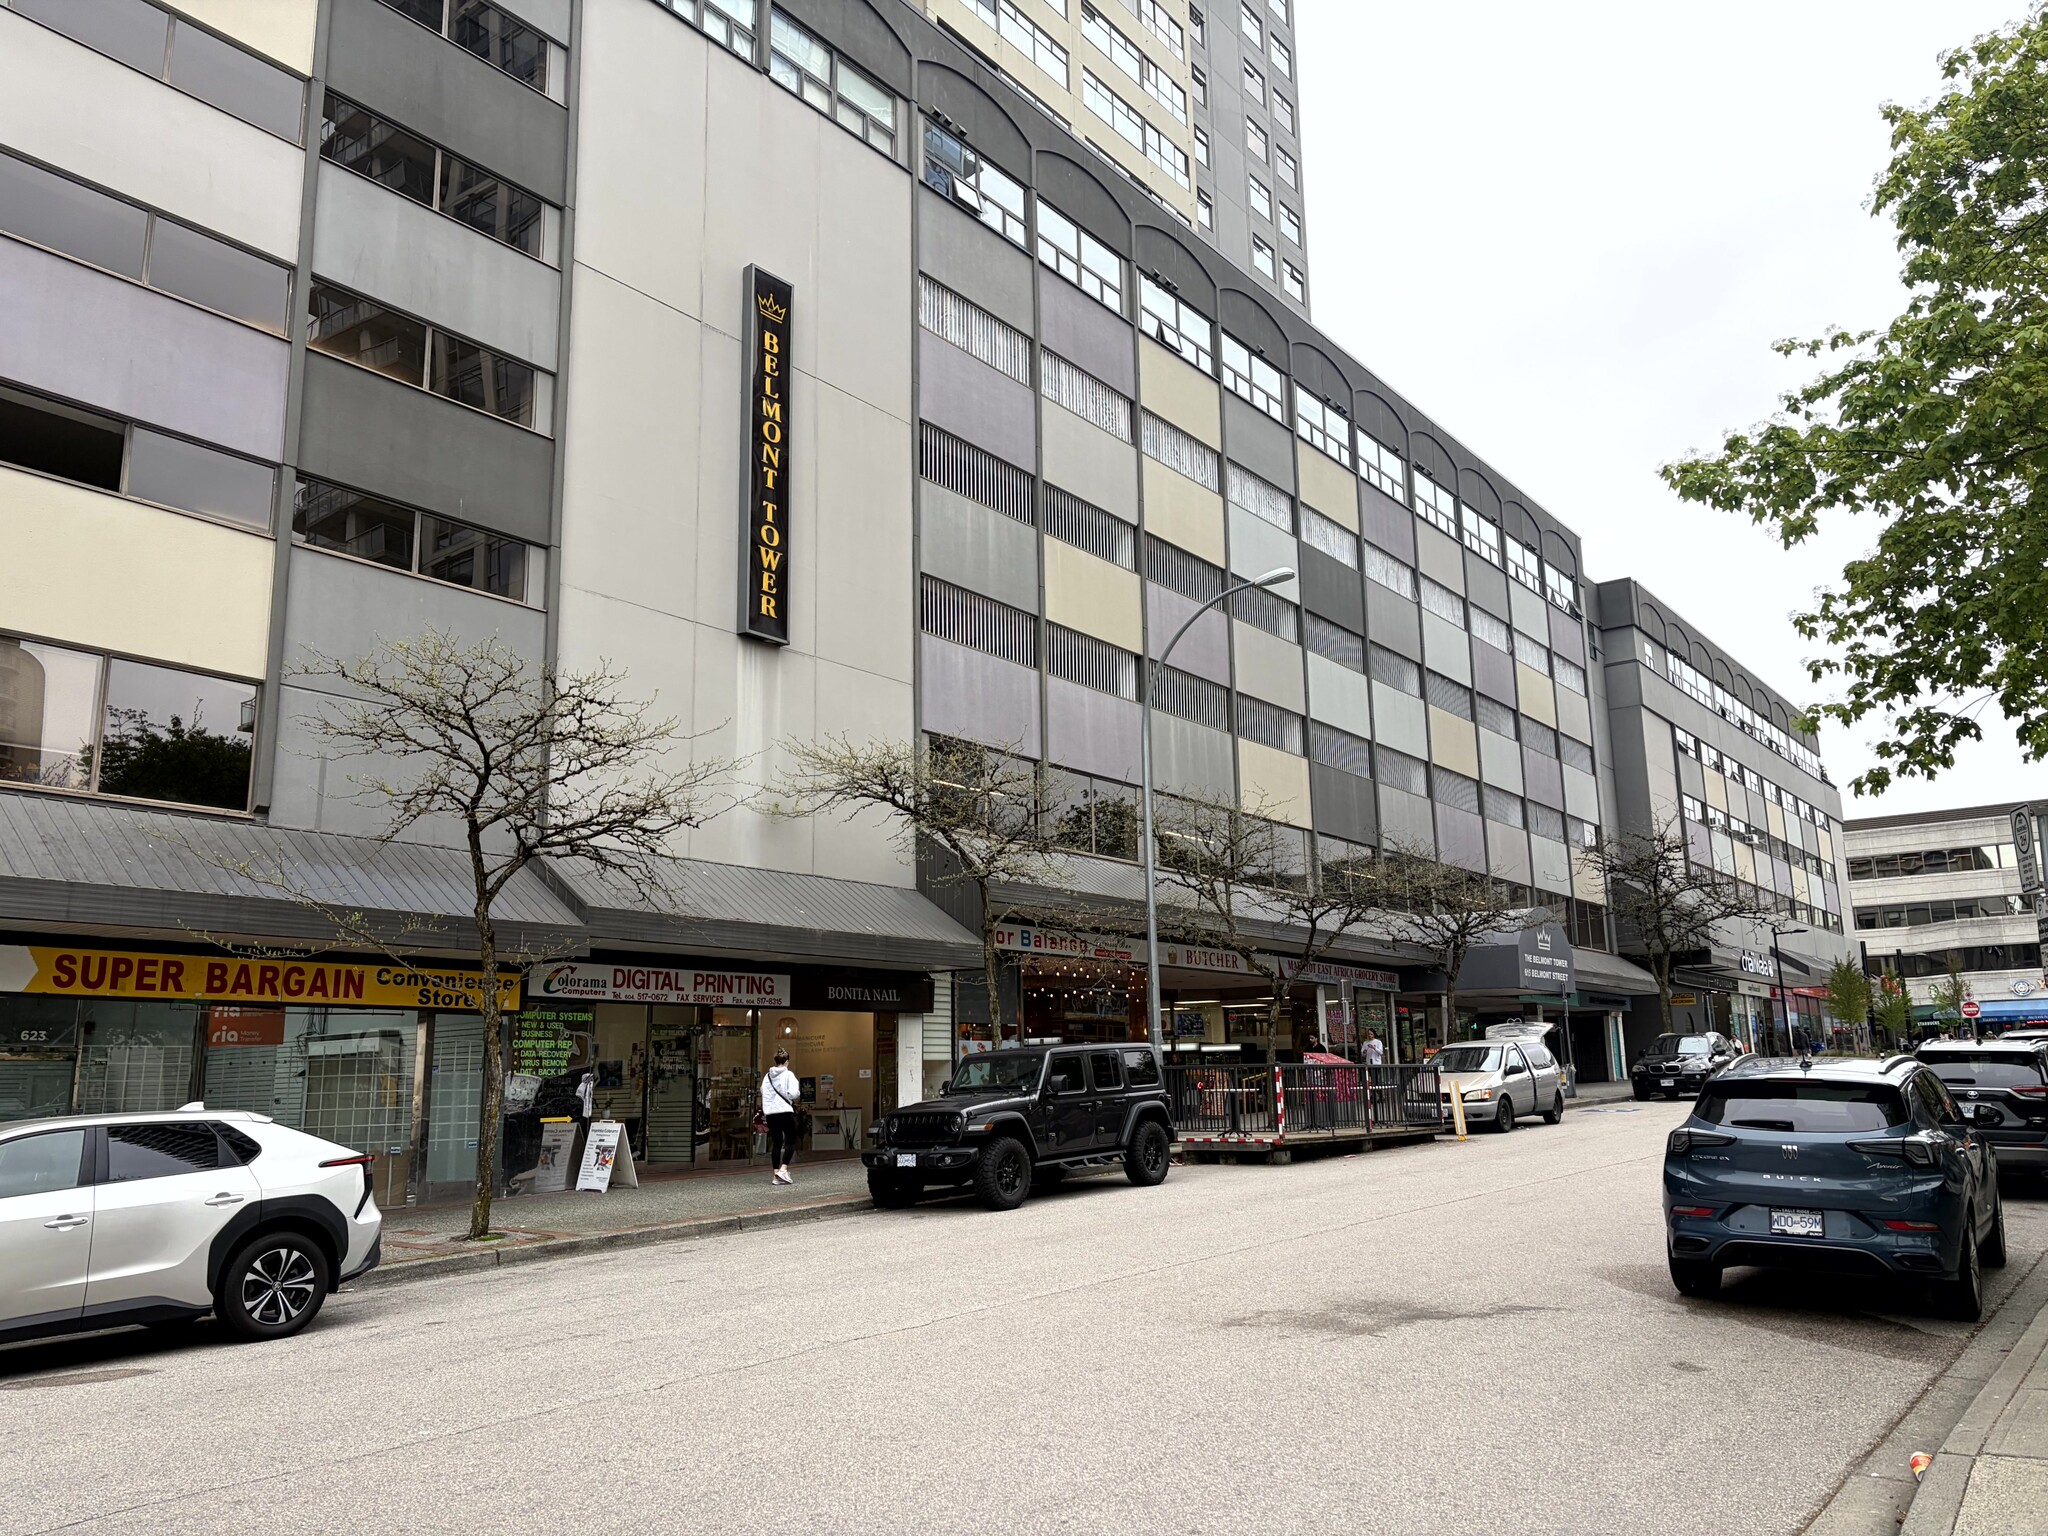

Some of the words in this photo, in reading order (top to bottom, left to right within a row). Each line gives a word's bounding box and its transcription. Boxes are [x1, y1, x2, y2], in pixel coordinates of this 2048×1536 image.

[761, 328, 782, 490] BELMONT
[758, 500, 783, 619] TOWER
[1186, 949, 1239, 969] BUTCHER
[1532, 955, 1553, 966] BELMONT
[1553, 958, 1569, 968] TOWER
[52, 953, 185, 993] SUPER
[205, 961, 365, 999] BARGAIN
[376, 967, 515, 992] Conveniece
[1317, 963, 1333, 975] EAST
[1333, 966, 1354, 979] AFRICA
[1354, 969, 1379, 981] GROCERY
[1379, 972, 1396, 984] STORE
[1531, 969, 1552, 979] BELMONT
[1552, 971, 1569, 982] STREET
[543, 965, 607, 994] Colorama
[612, 967, 685, 992] DIGITAL
[693, 973, 775, 996] PRINTING
[417, 988, 476, 1007] Store
[561, 986, 606, 997] Computers
[637, 992, 668, 1001] 517-0672
[676, 993, 690, 1002] FAX
[692, 994, 724, 1004] SERVICES
[827, 986, 871, 1001] BONITA
[872, 988, 901, 1002] NAIL
[558, 1012, 594, 1022] SYSTEMS
[521, 1021, 538, 1029] NEW
[546, 1022, 565, 1030] USED
[20, 1030, 47, 1042] 623
[211, 1025, 239, 1043] ria
[521, 1030, 553, 1039] BUSINESS
[512, 1039, 556, 1050] COMPUTER
[520, 1050, 536, 1058] DATA
[538, 1050, 572, 1059] RECOVERY
[520, 1059, 540, 1067] VIRUS
[538, 1069, 557, 1077] BACK
[1762, 1174, 1822, 1182] BUICK
